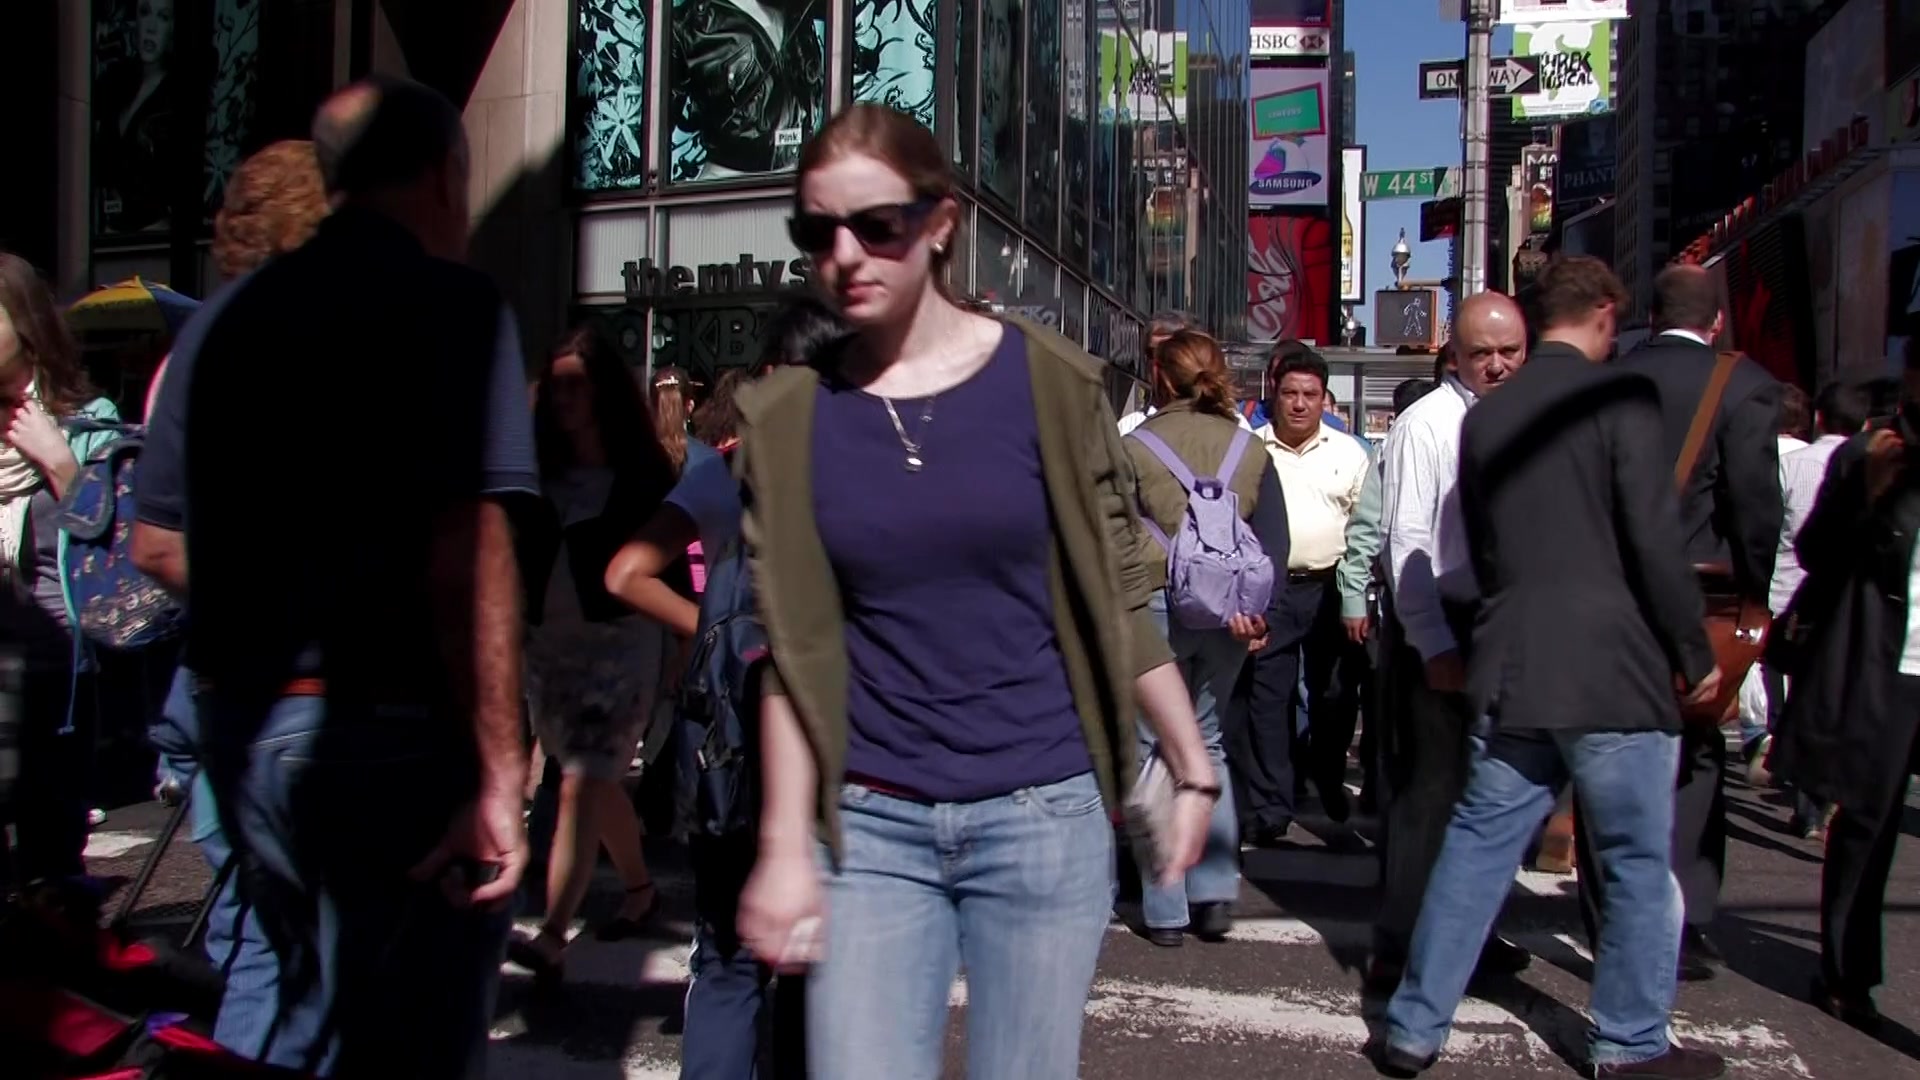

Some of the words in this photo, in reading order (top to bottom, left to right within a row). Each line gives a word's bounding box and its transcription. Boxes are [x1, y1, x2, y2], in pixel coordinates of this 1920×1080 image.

[1436, 72, 1459, 87] ON
[779, 132, 798, 143] Pink
[1258, 177, 1313, 190] SAMSUNG
[1363, 174, 1381, 197] W
[1387, 173, 1416, 195] 44
[1420, 173, 1434, 185] ST
